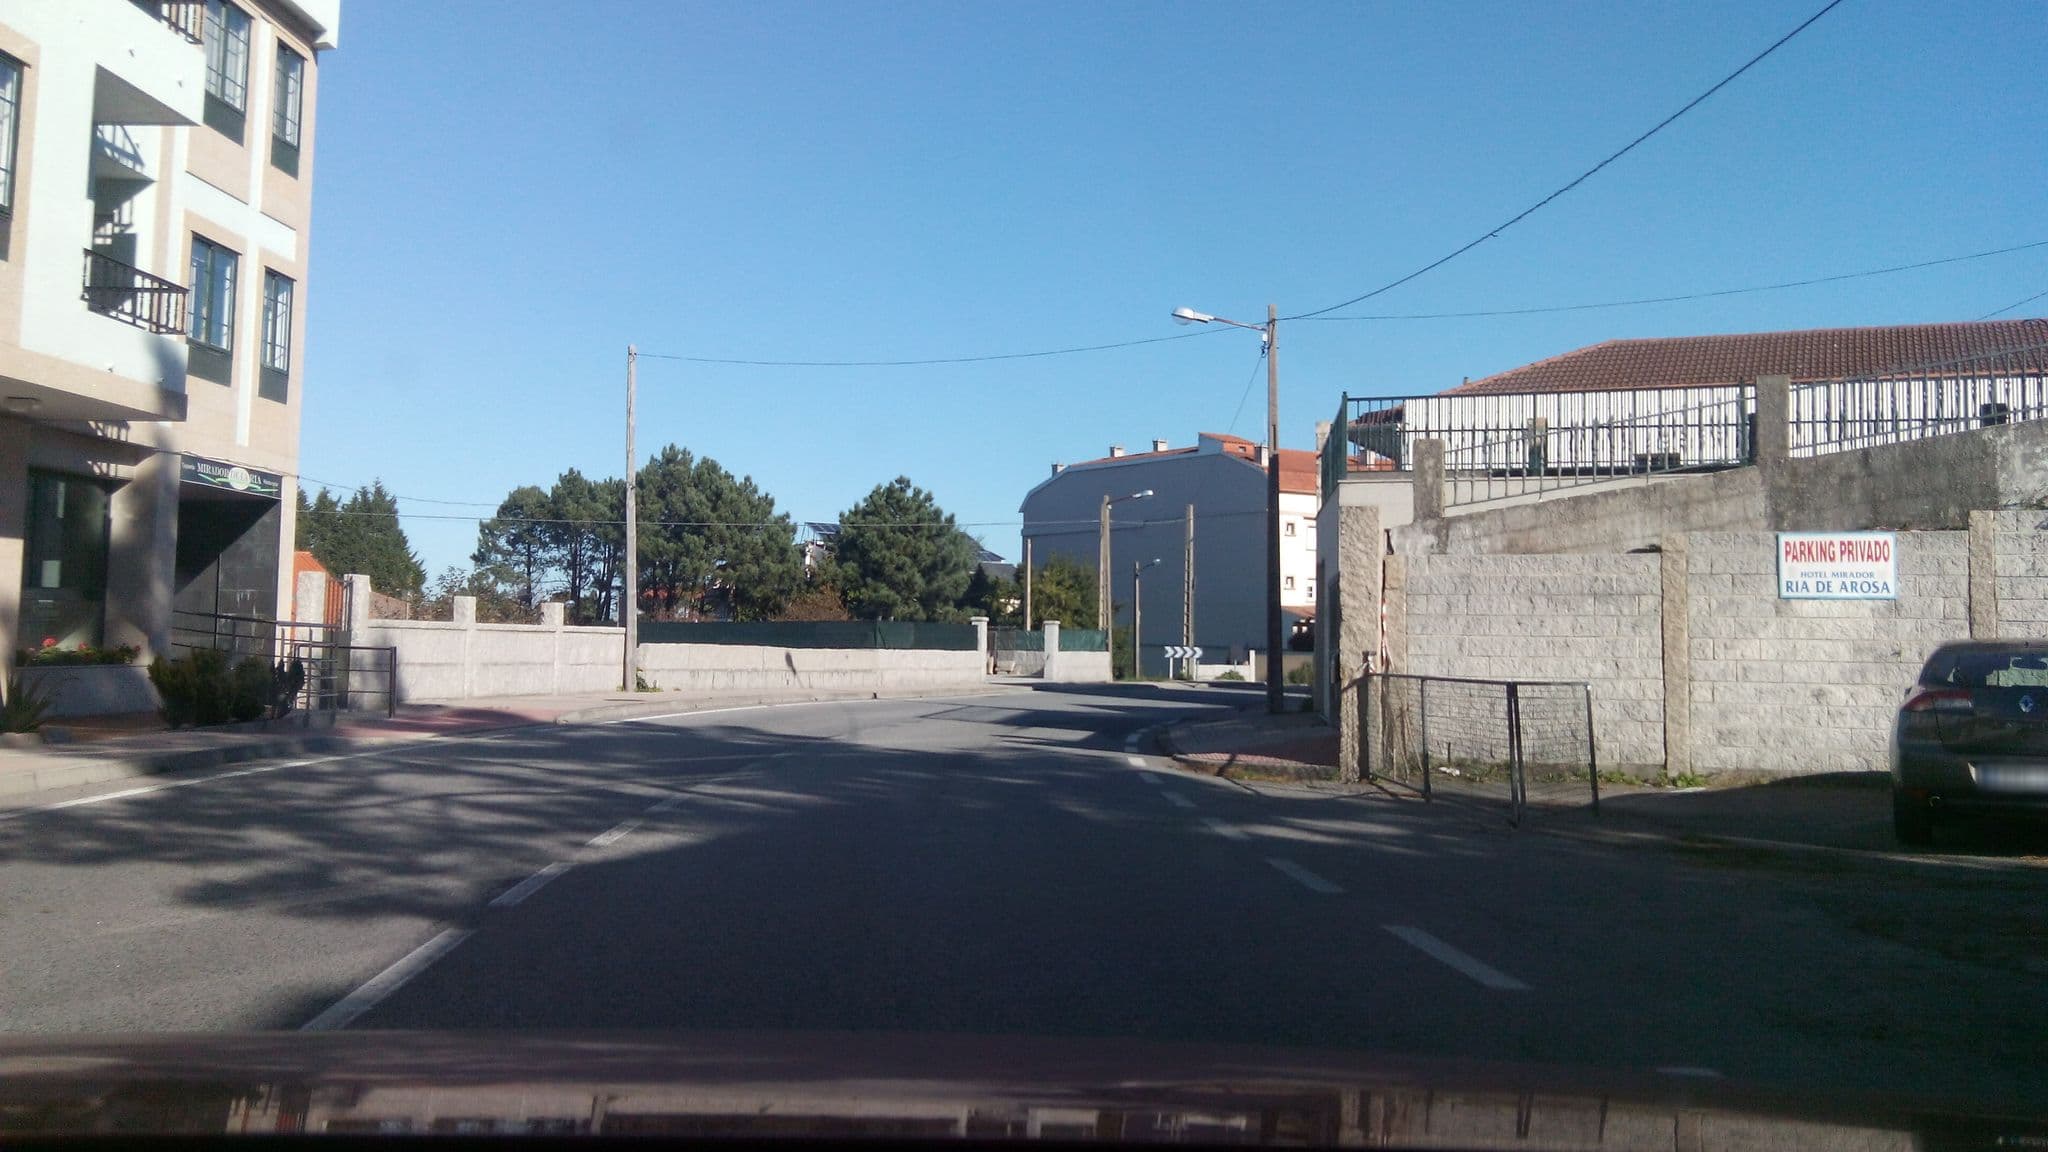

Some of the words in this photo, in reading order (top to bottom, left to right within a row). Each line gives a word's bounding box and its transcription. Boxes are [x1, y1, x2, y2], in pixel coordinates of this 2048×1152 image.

[197, 462, 229, 477] MIRADOR
[1784, 540, 1835, 562] PARKING
[1839, 540, 1890, 562] PRIVADO
[1785, 581, 1810, 593] RIA
[1816, 580, 1832, 593] DE
[1839, 580, 1891, 594] AROSA
